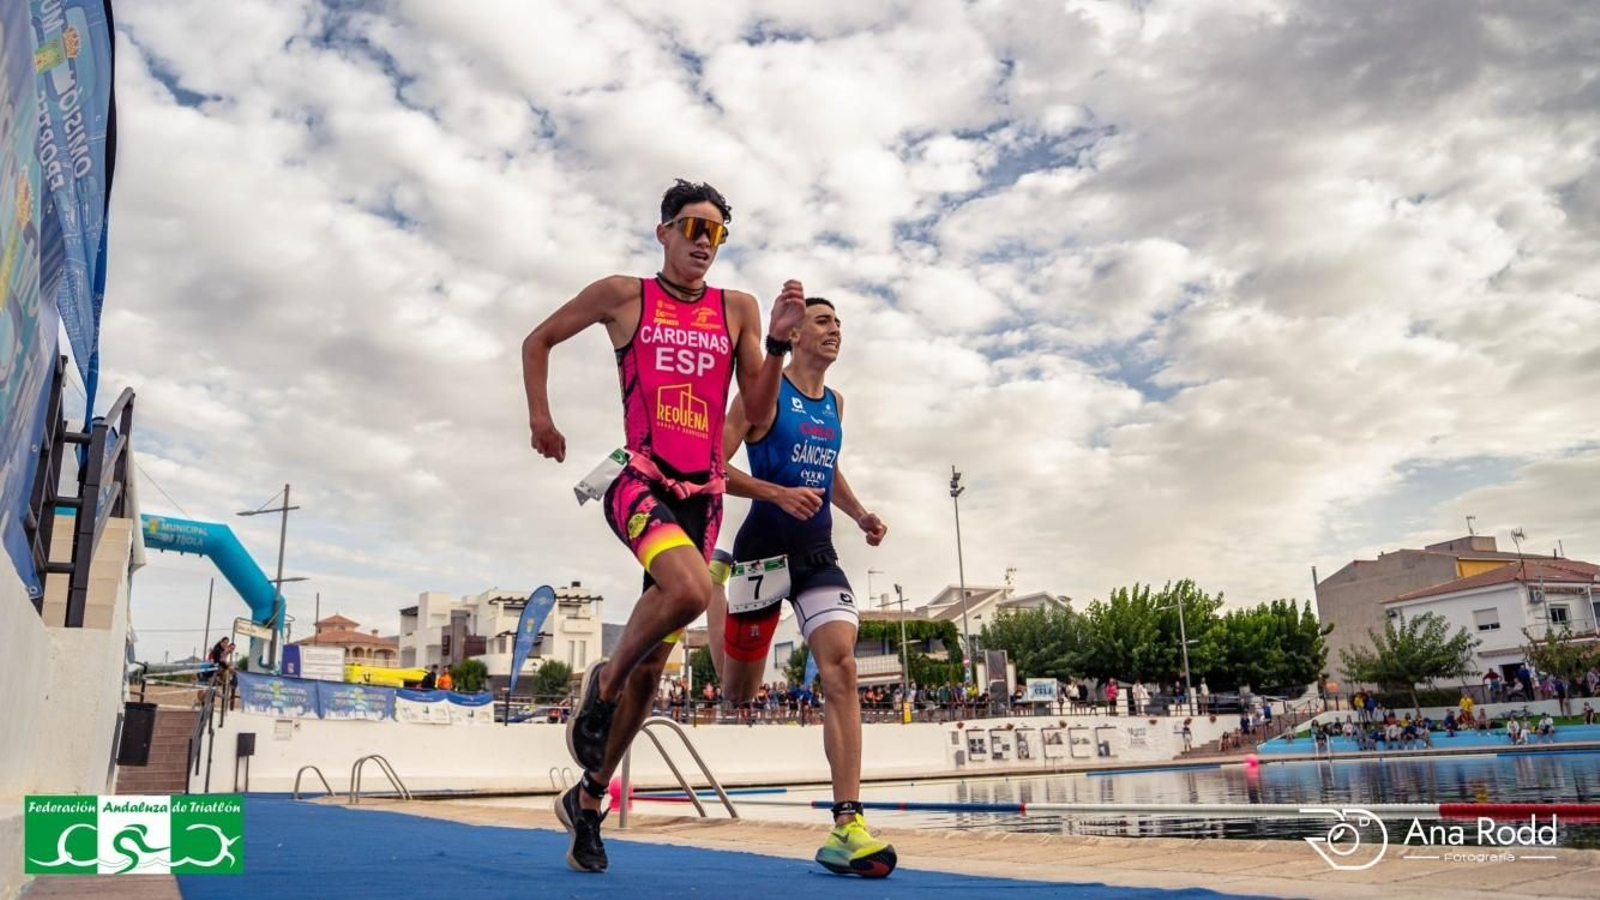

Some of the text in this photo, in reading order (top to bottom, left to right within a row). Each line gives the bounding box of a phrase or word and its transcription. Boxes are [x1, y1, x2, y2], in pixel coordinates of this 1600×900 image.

[641, 323, 729, 355] CÁRDENAS
[655, 346, 716, 377] ESP
[657, 401, 709, 432] REQUENA
[791, 439, 837, 469] SÁNCHEZ
[161, 521, 208, 536] MUNICIPAL
[747, 574, 764, 600] 7
